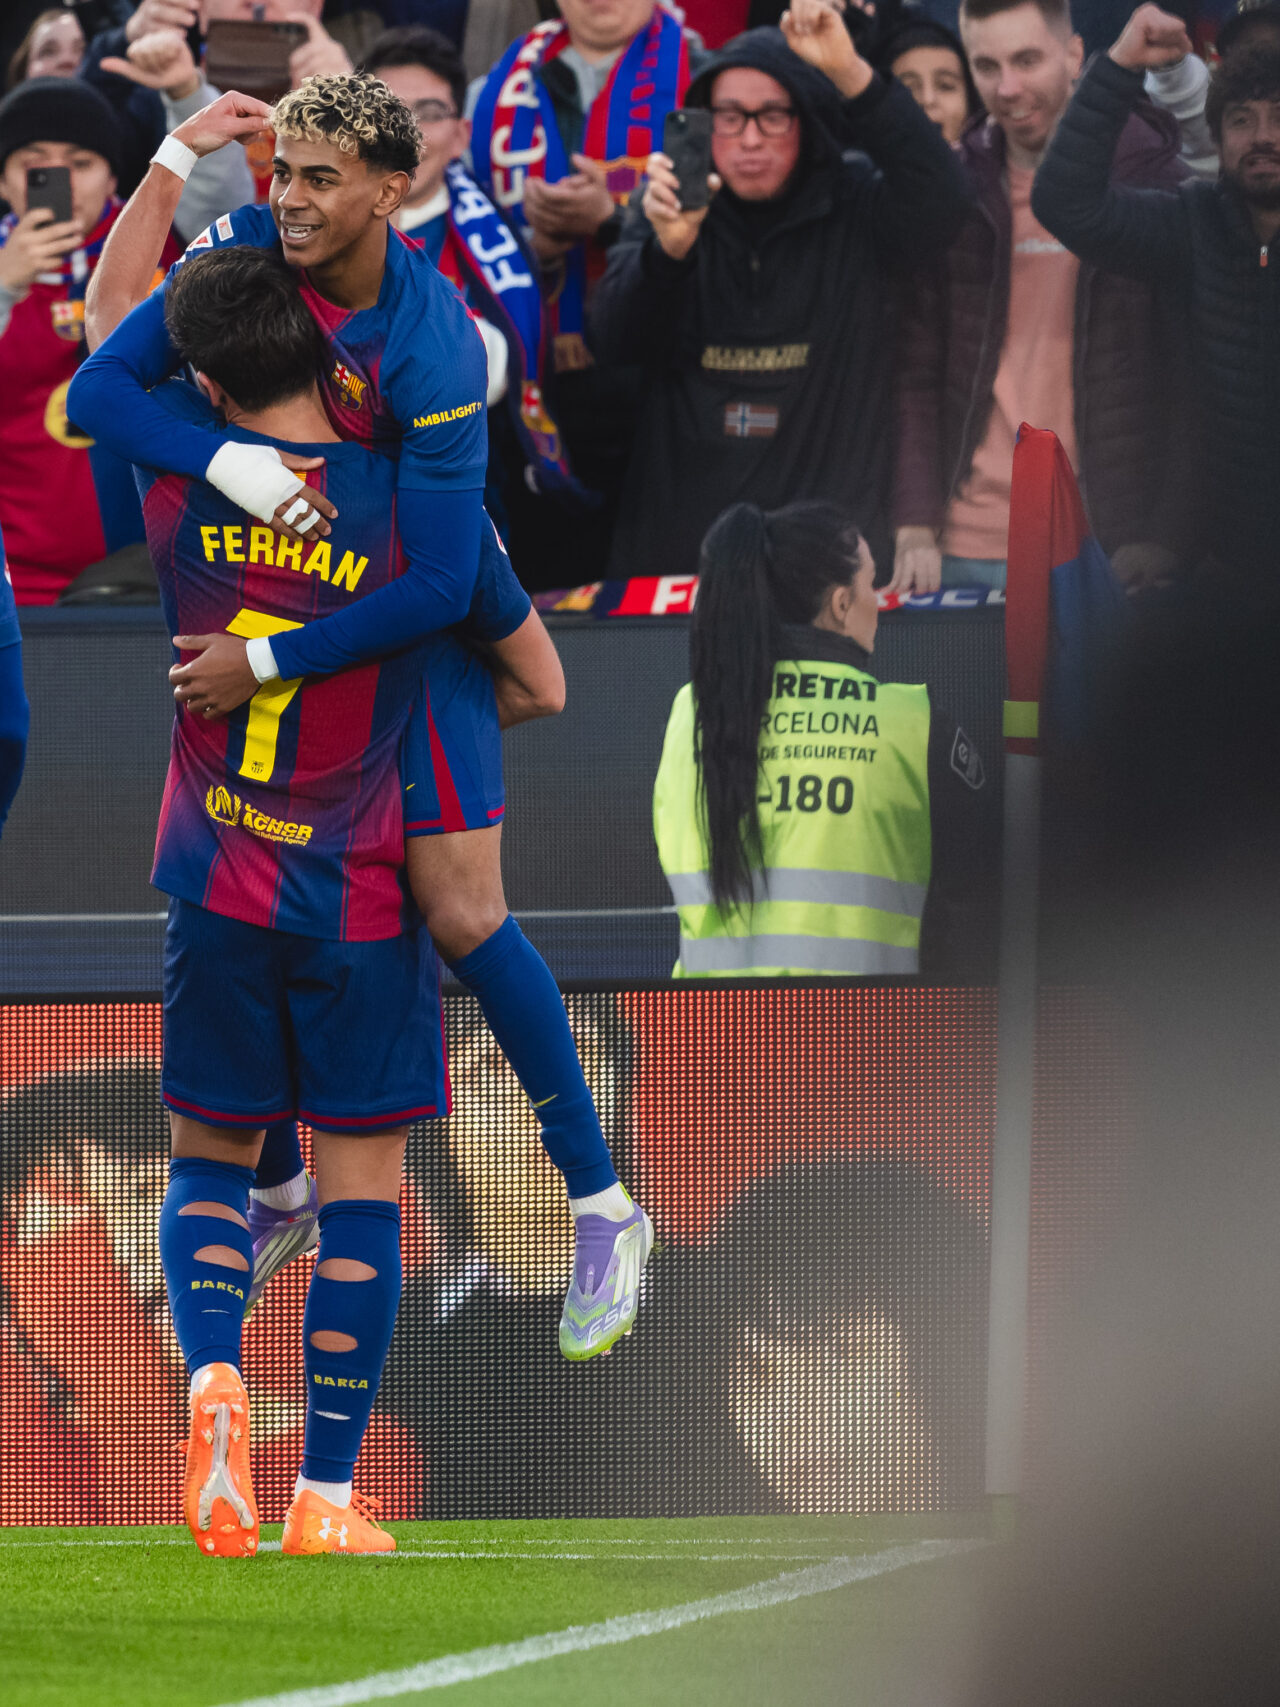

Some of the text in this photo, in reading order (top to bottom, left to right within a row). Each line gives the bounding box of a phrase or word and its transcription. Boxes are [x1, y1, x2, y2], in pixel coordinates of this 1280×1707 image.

[467, 223, 533, 294] FC
[413, 402, 477, 428] AMBILIGHT
[200, 525, 369, 593] FERRAN
[650, 575, 699, 614] F
[225, 608, 306, 782] 7
[775, 672, 877, 702] RETAT
[760, 711, 879, 737] RCELONA
[783, 744, 878, 763] SEGURETAT
[585, 1297, 634, 1350] F50
